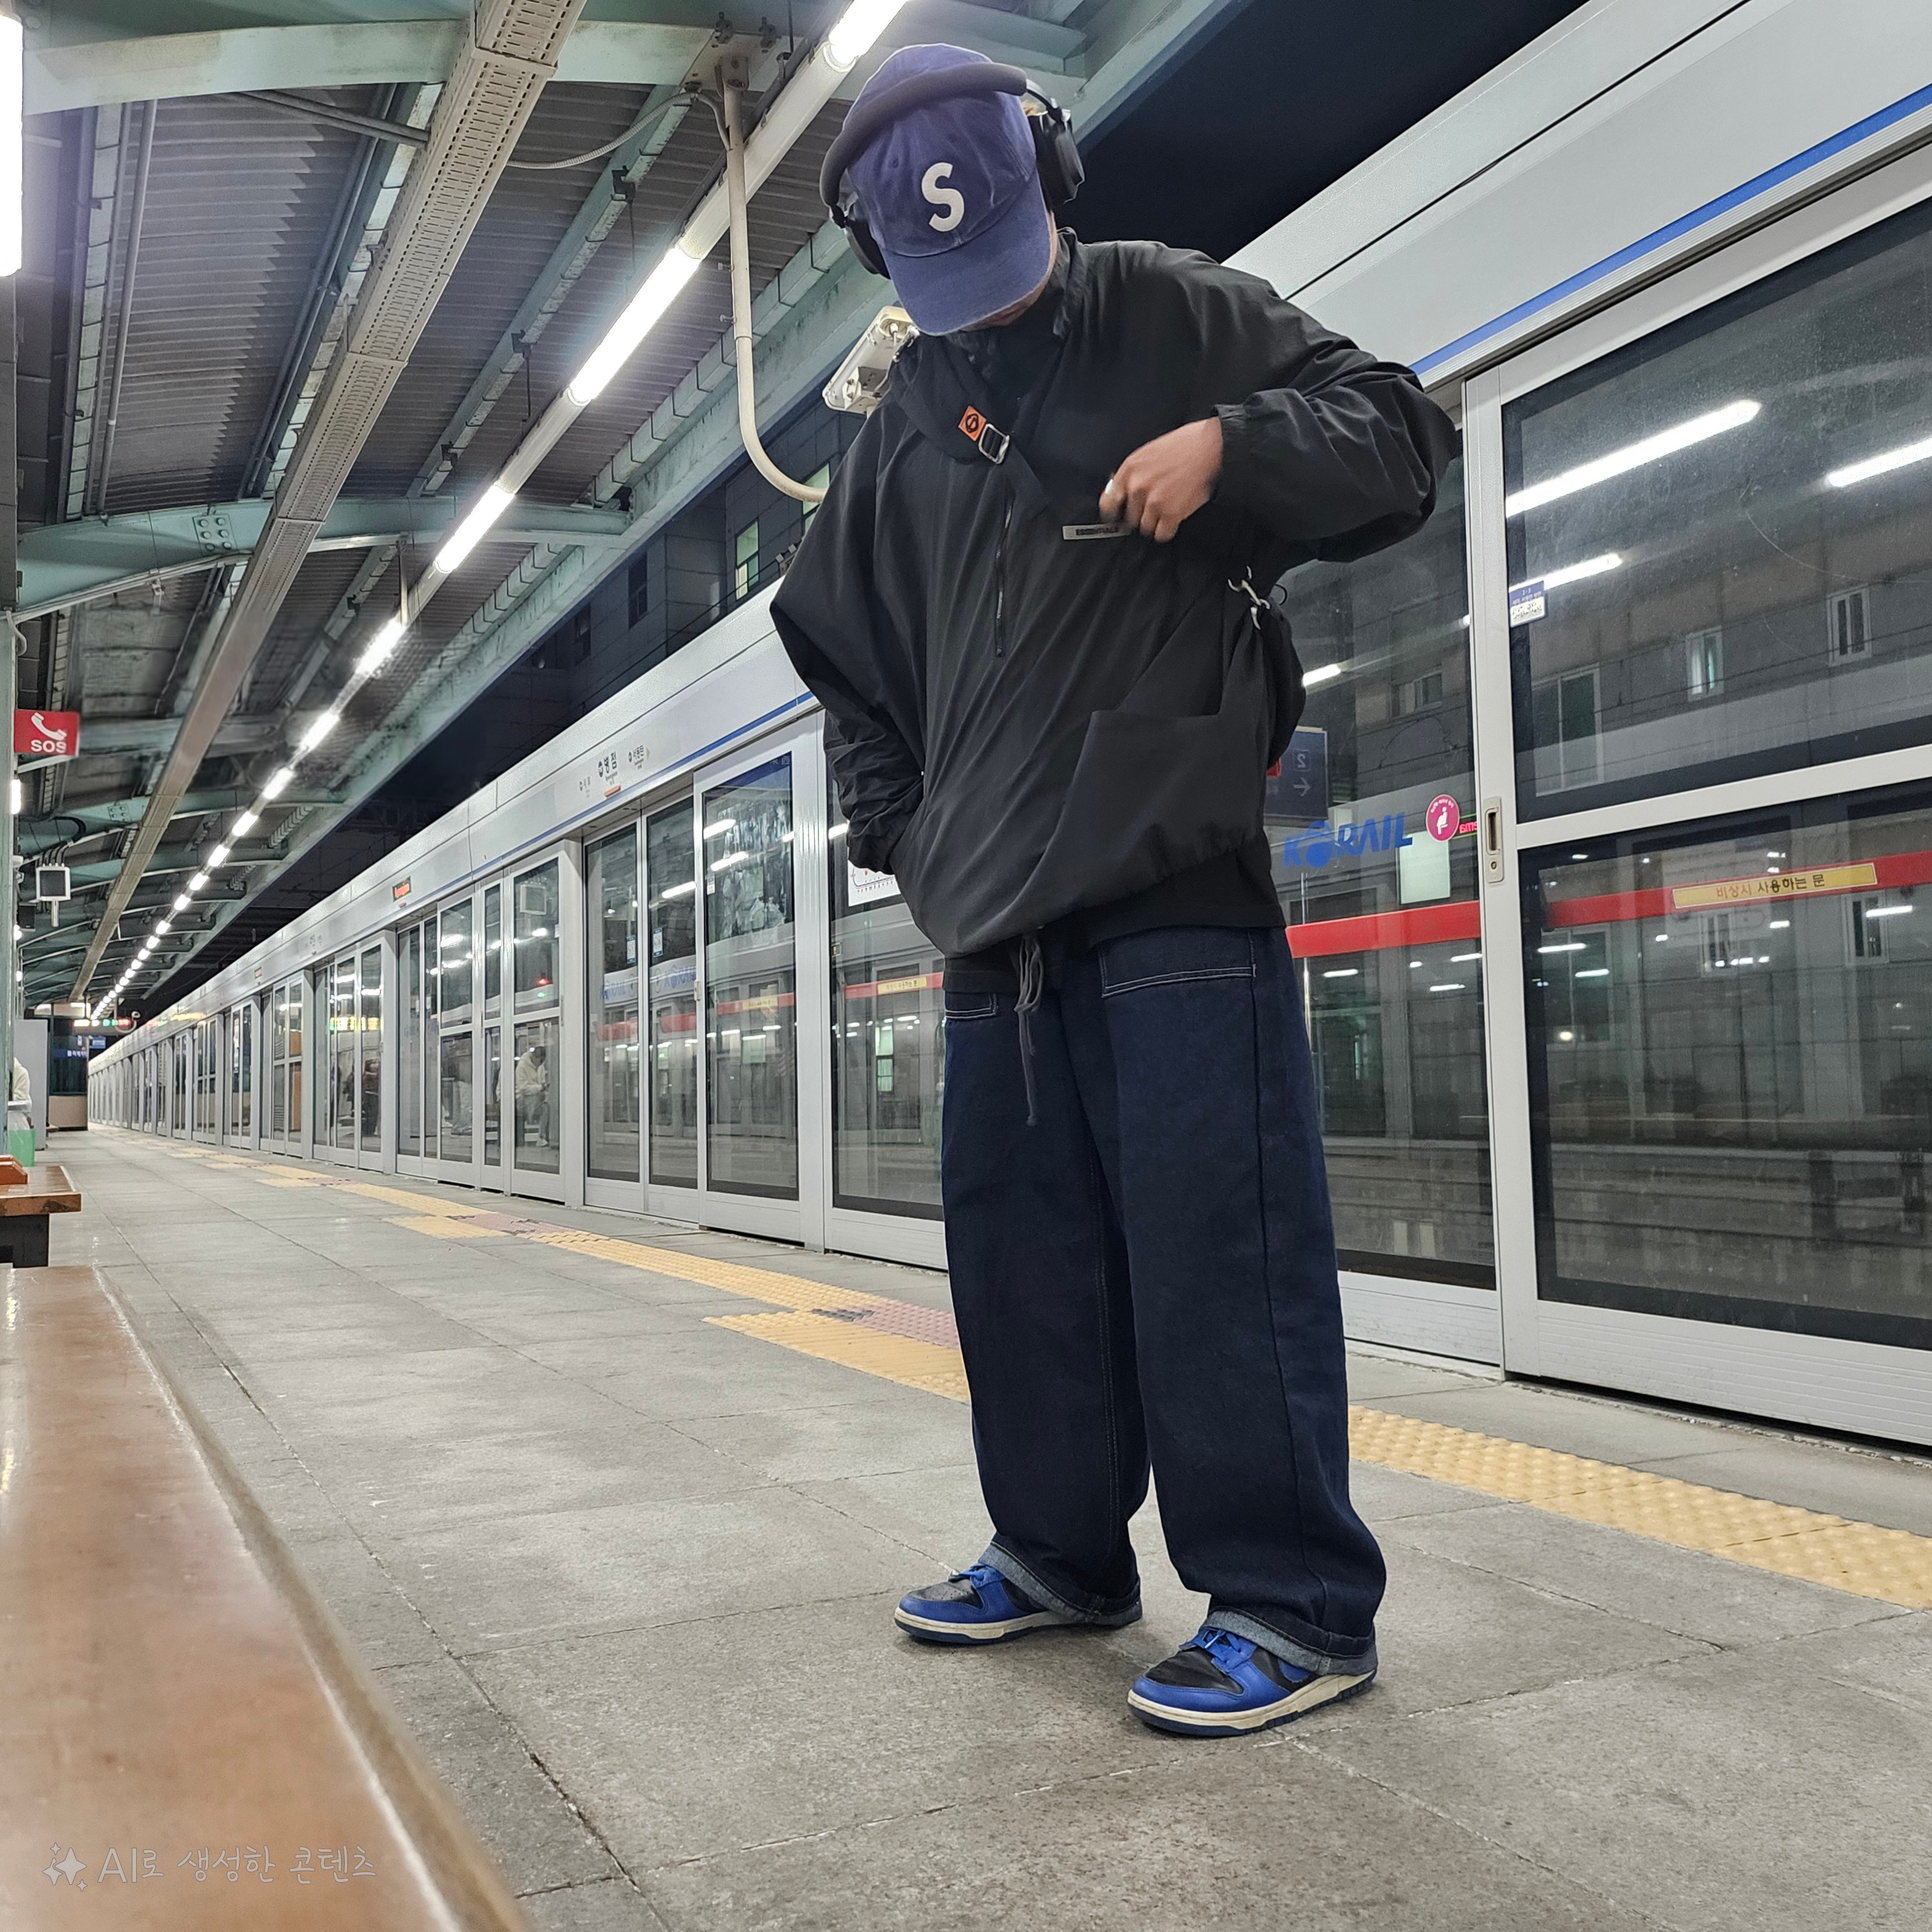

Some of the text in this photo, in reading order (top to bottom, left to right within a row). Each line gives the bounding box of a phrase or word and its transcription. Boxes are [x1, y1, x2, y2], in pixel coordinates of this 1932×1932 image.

[921, 162, 964, 232] S
[30, 739, 67, 753] SOS
[1283, 812, 1413, 869] KORAIL
[1716, 874, 1825, 899] 비상시 사용하는 문
